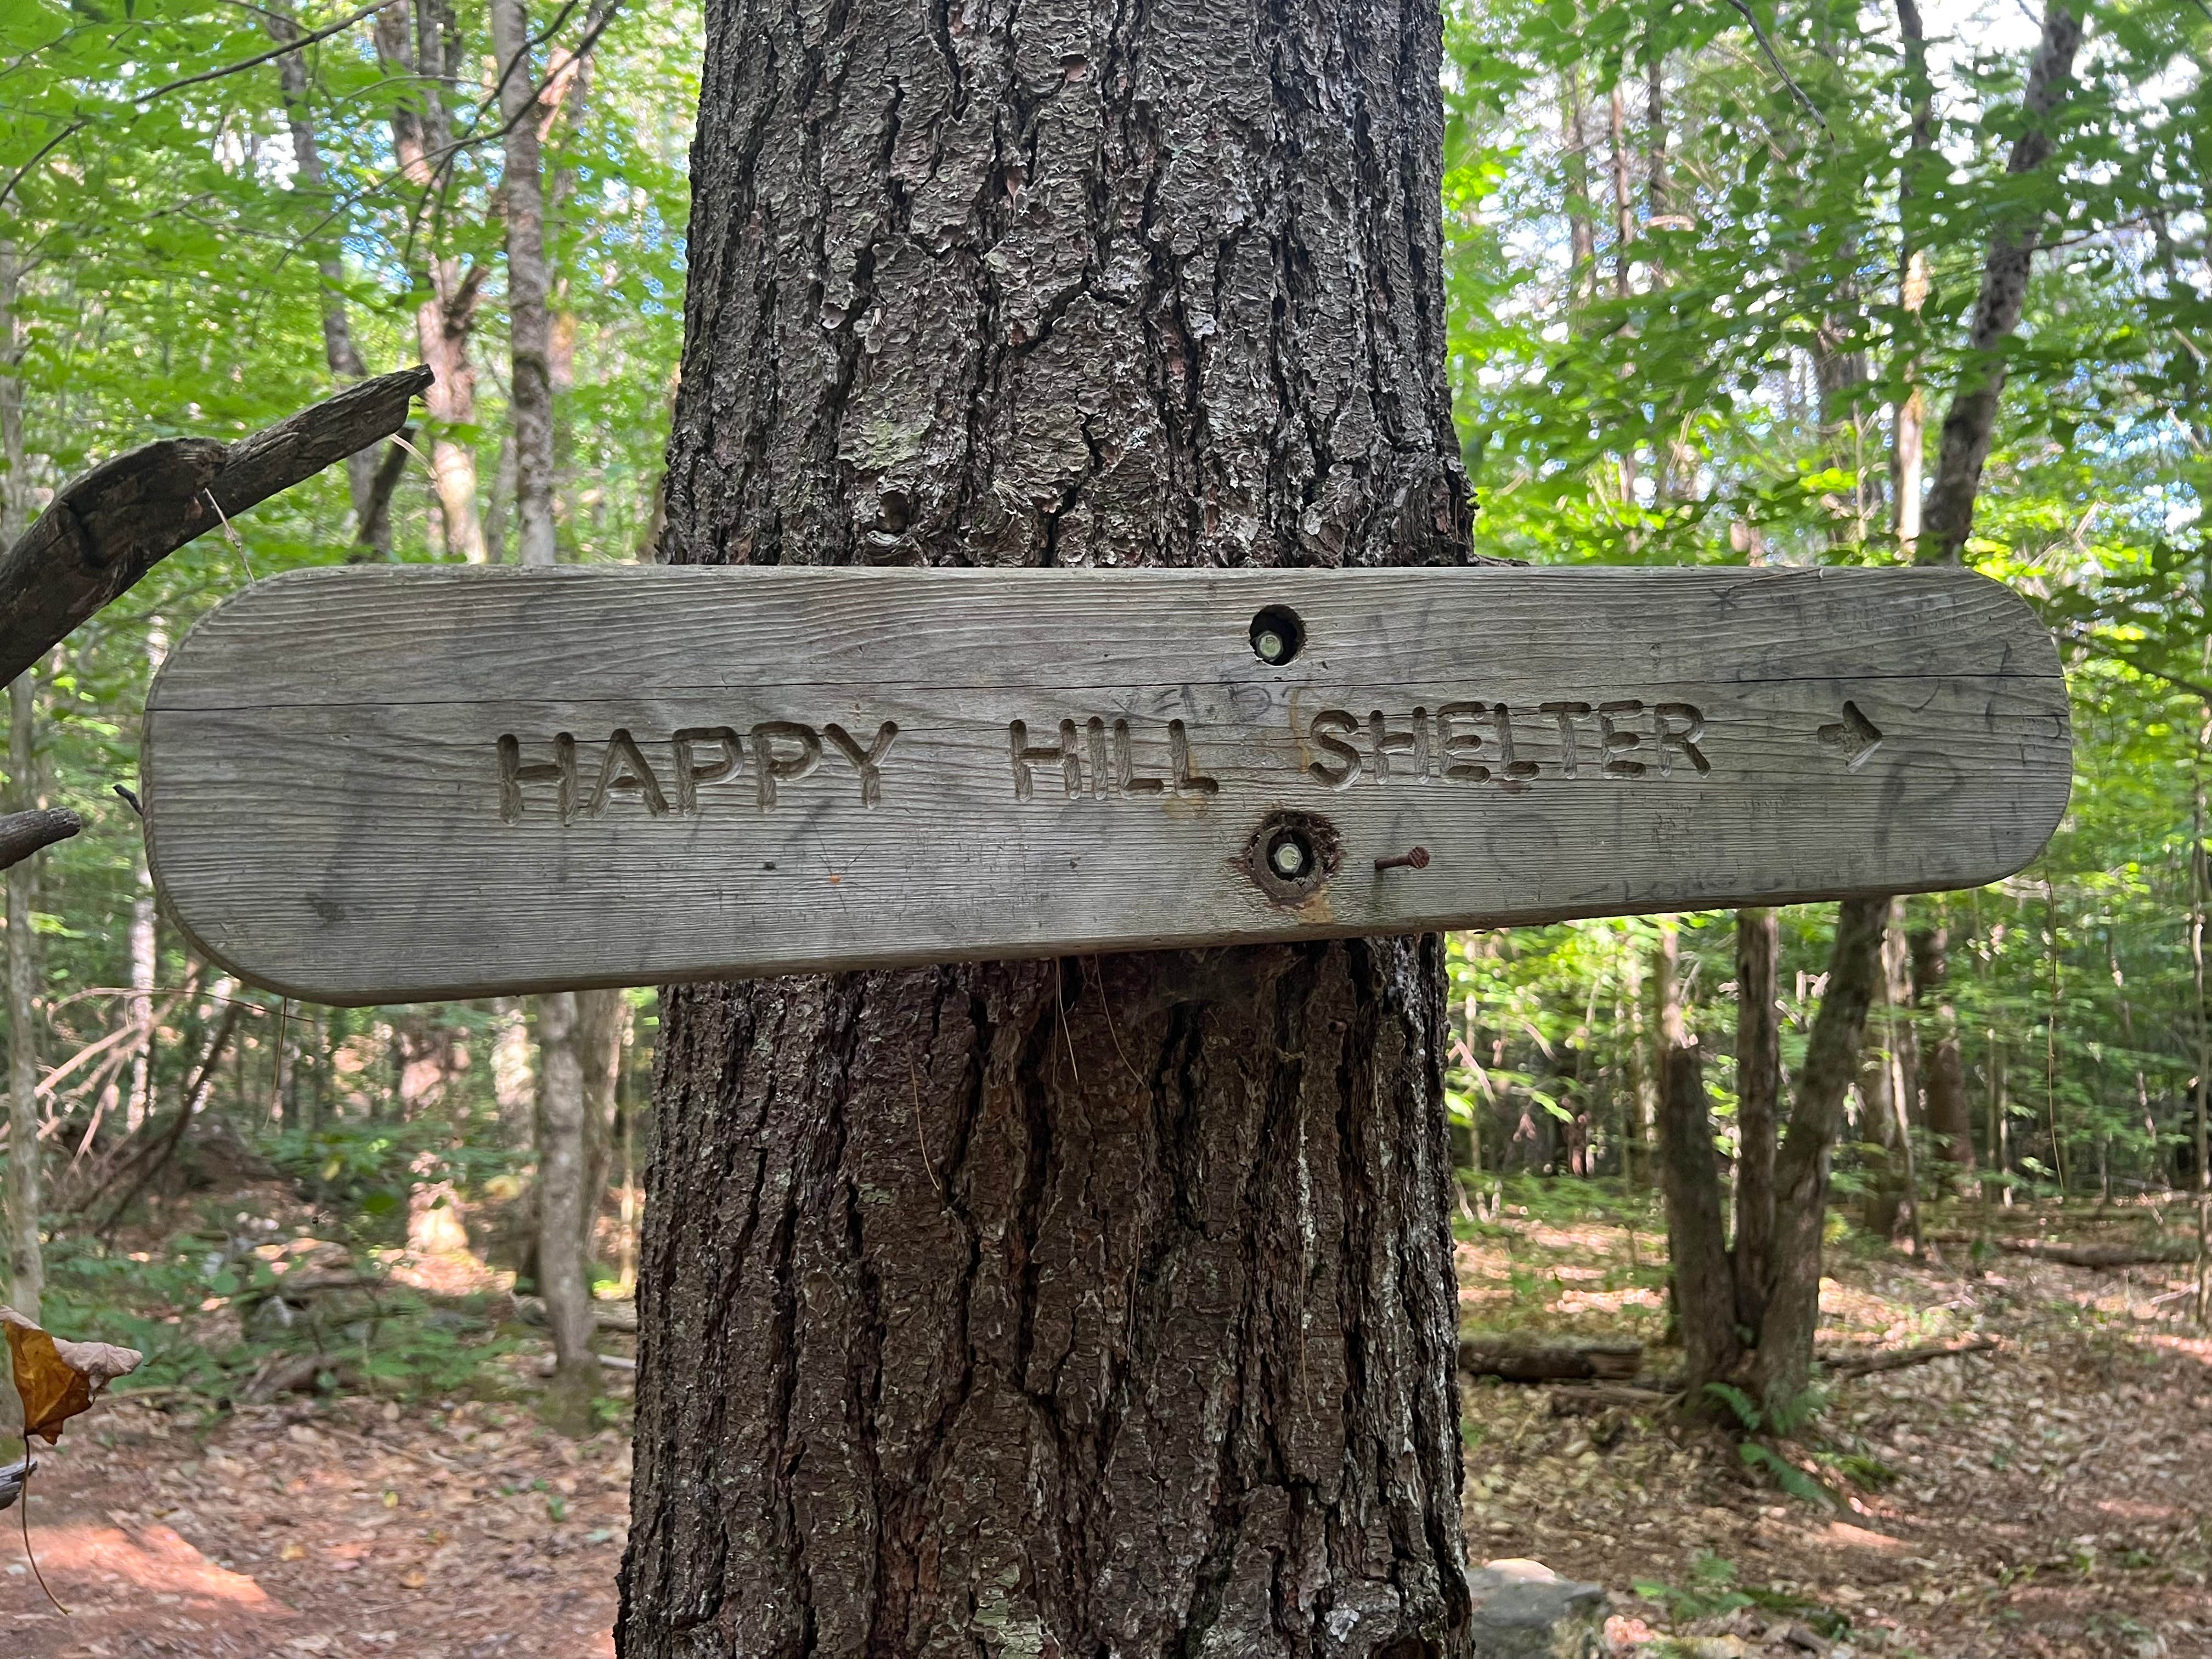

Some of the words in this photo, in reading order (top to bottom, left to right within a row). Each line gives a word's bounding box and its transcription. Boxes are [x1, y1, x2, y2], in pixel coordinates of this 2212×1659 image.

[497, 720, 899, 827] HAPPY
[1009, 716, 1219, 802] HILL
[1308, 699, 1712, 791] SHELTER
